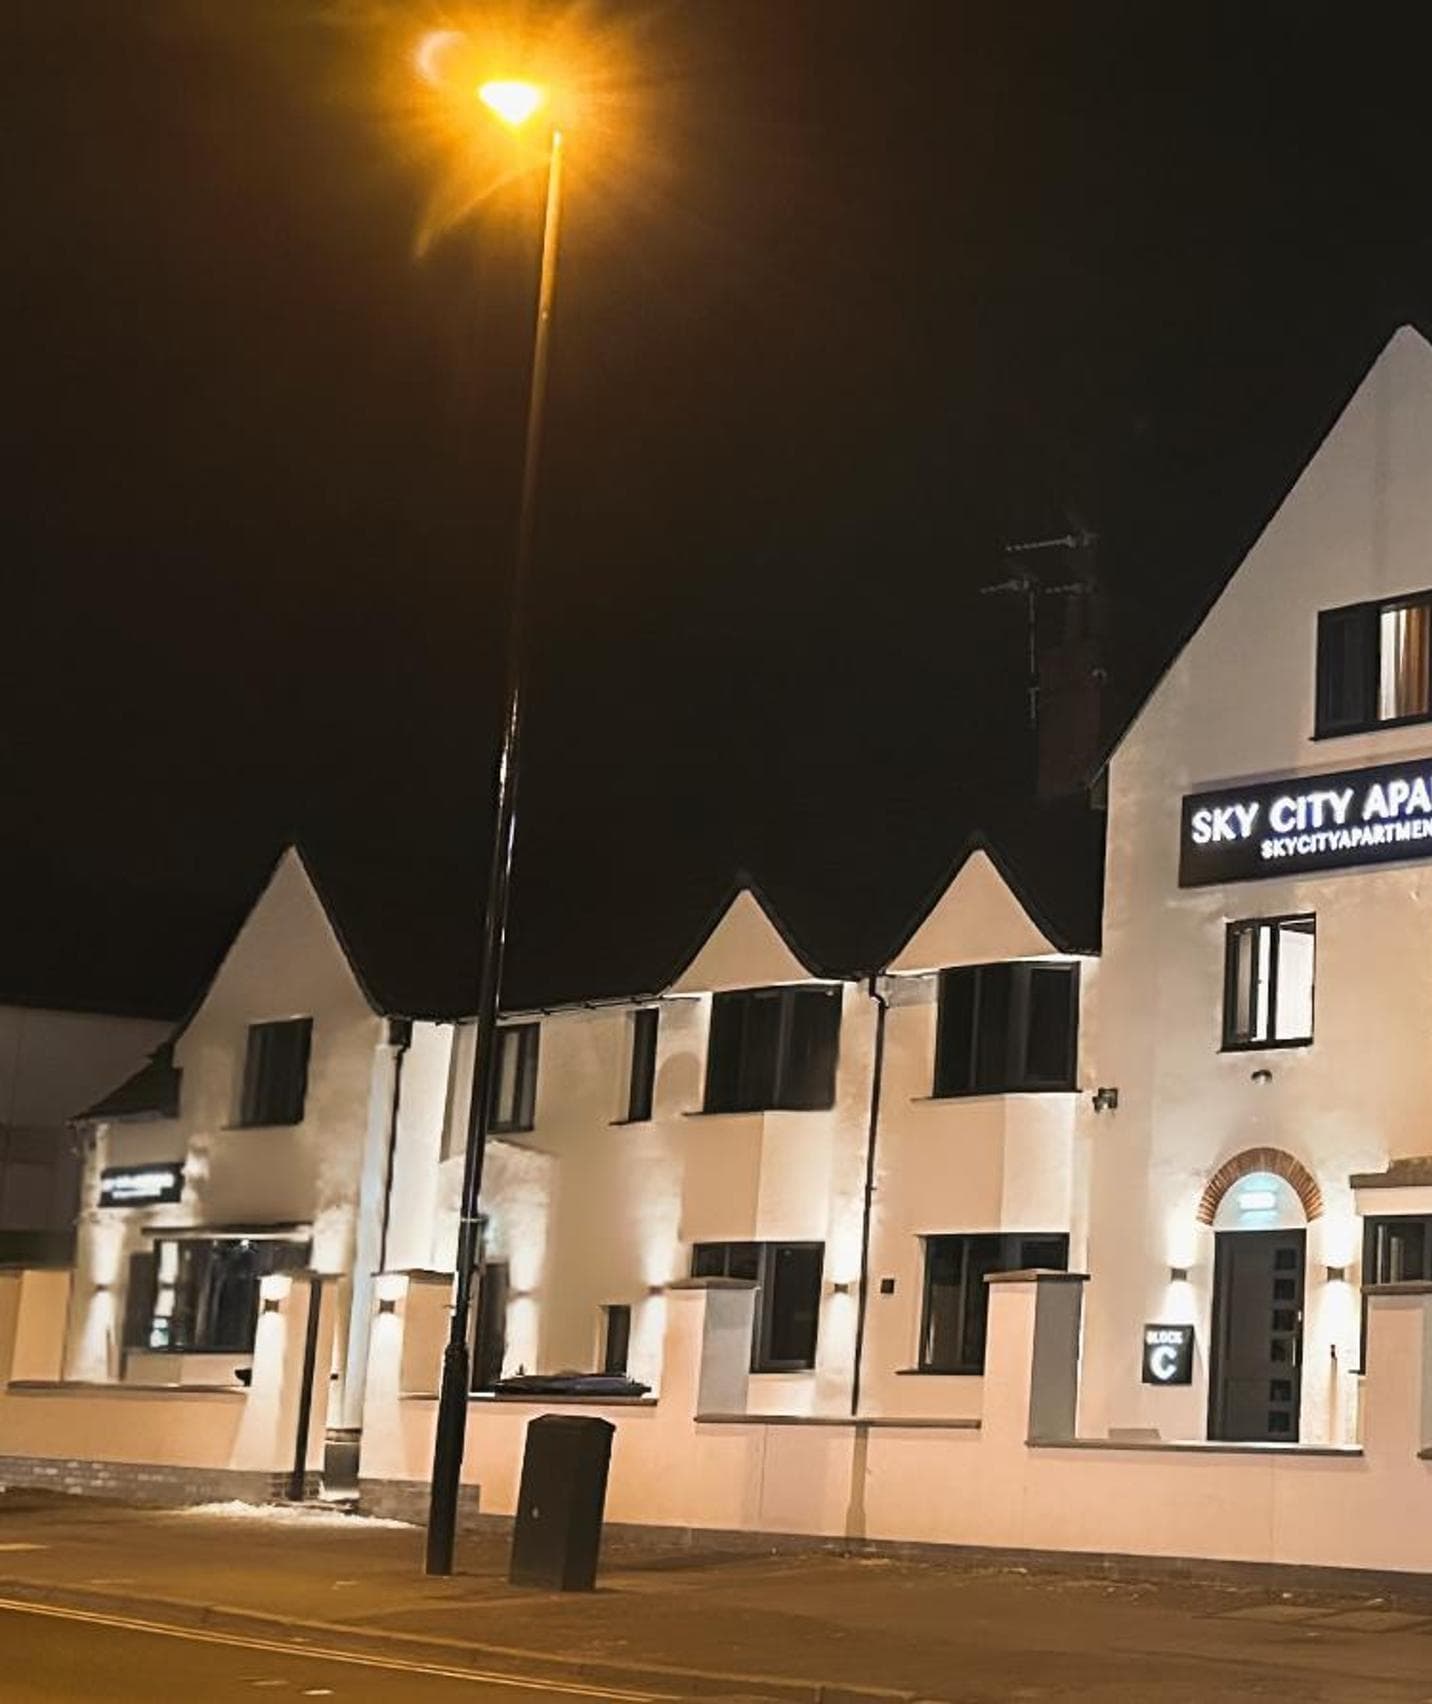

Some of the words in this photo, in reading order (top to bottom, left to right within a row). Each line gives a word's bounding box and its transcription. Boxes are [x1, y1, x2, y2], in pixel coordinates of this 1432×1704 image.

[1191, 804, 1259, 845] SKY
[1269, 789, 1354, 834] CITY
[1146, 1331, 1183, 1345] BLOCK
[1151, 1345, 1177, 1380] C
